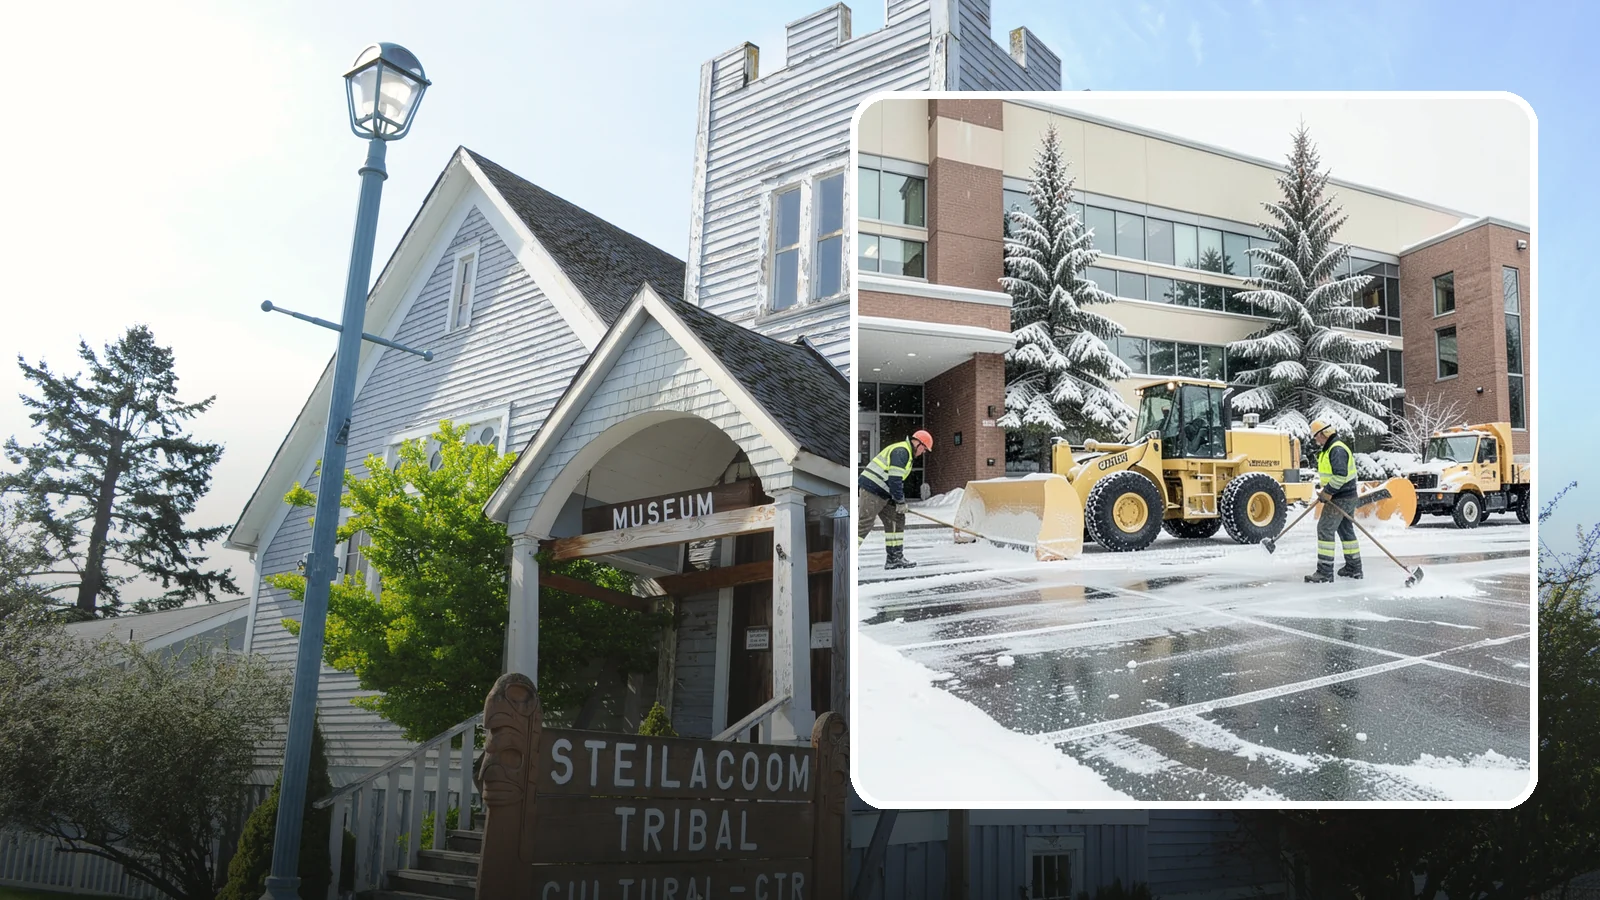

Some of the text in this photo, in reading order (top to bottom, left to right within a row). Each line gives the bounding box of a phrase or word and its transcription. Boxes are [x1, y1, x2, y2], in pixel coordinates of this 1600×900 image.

[613, 491, 714, 531] MUSEUM
[550, 738, 810, 792] STEILACOOM
[615, 806, 757, 852] TRIBAL
